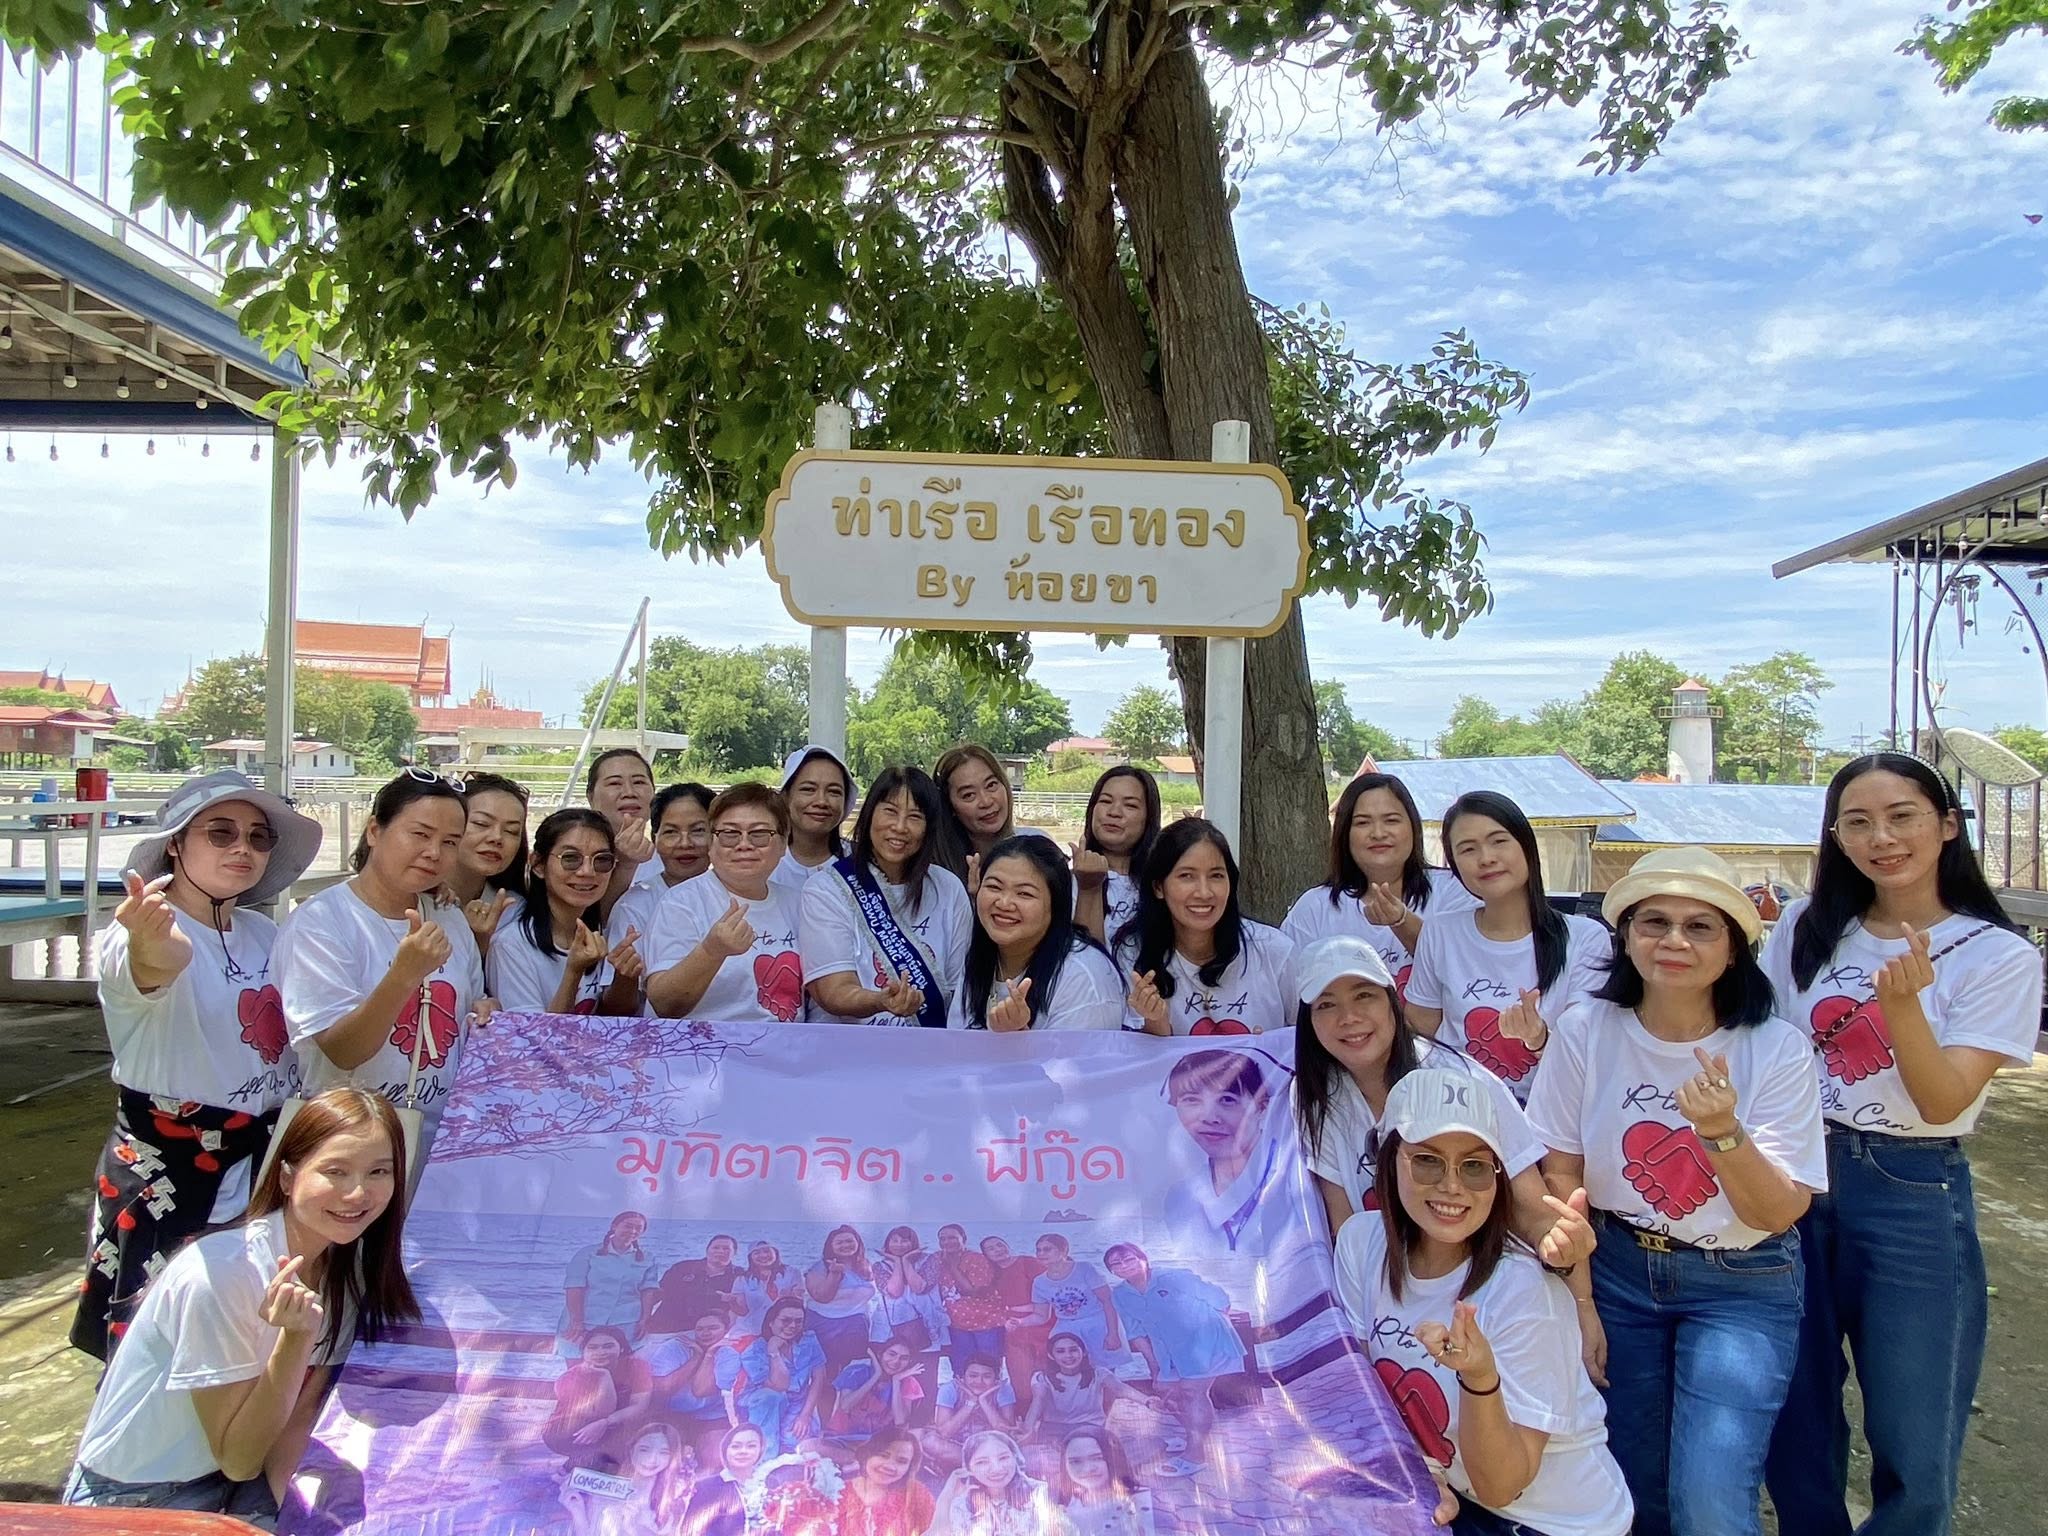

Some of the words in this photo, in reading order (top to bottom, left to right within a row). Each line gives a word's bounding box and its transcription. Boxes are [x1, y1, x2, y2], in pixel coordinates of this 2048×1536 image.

[831, 475, 997, 541] ท่าเรือ
[1027, 481, 1246, 548] เรือทอง
[916, 564, 976, 607] By
[1003, 550, 1158, 604] ห้อยขา
[1852, 1102, 1914, 1131] Can
[615, 1131, 902, 1193] มุทิตาจิต
[976, 1117, 1126, 1201] พี่กู๊ด
